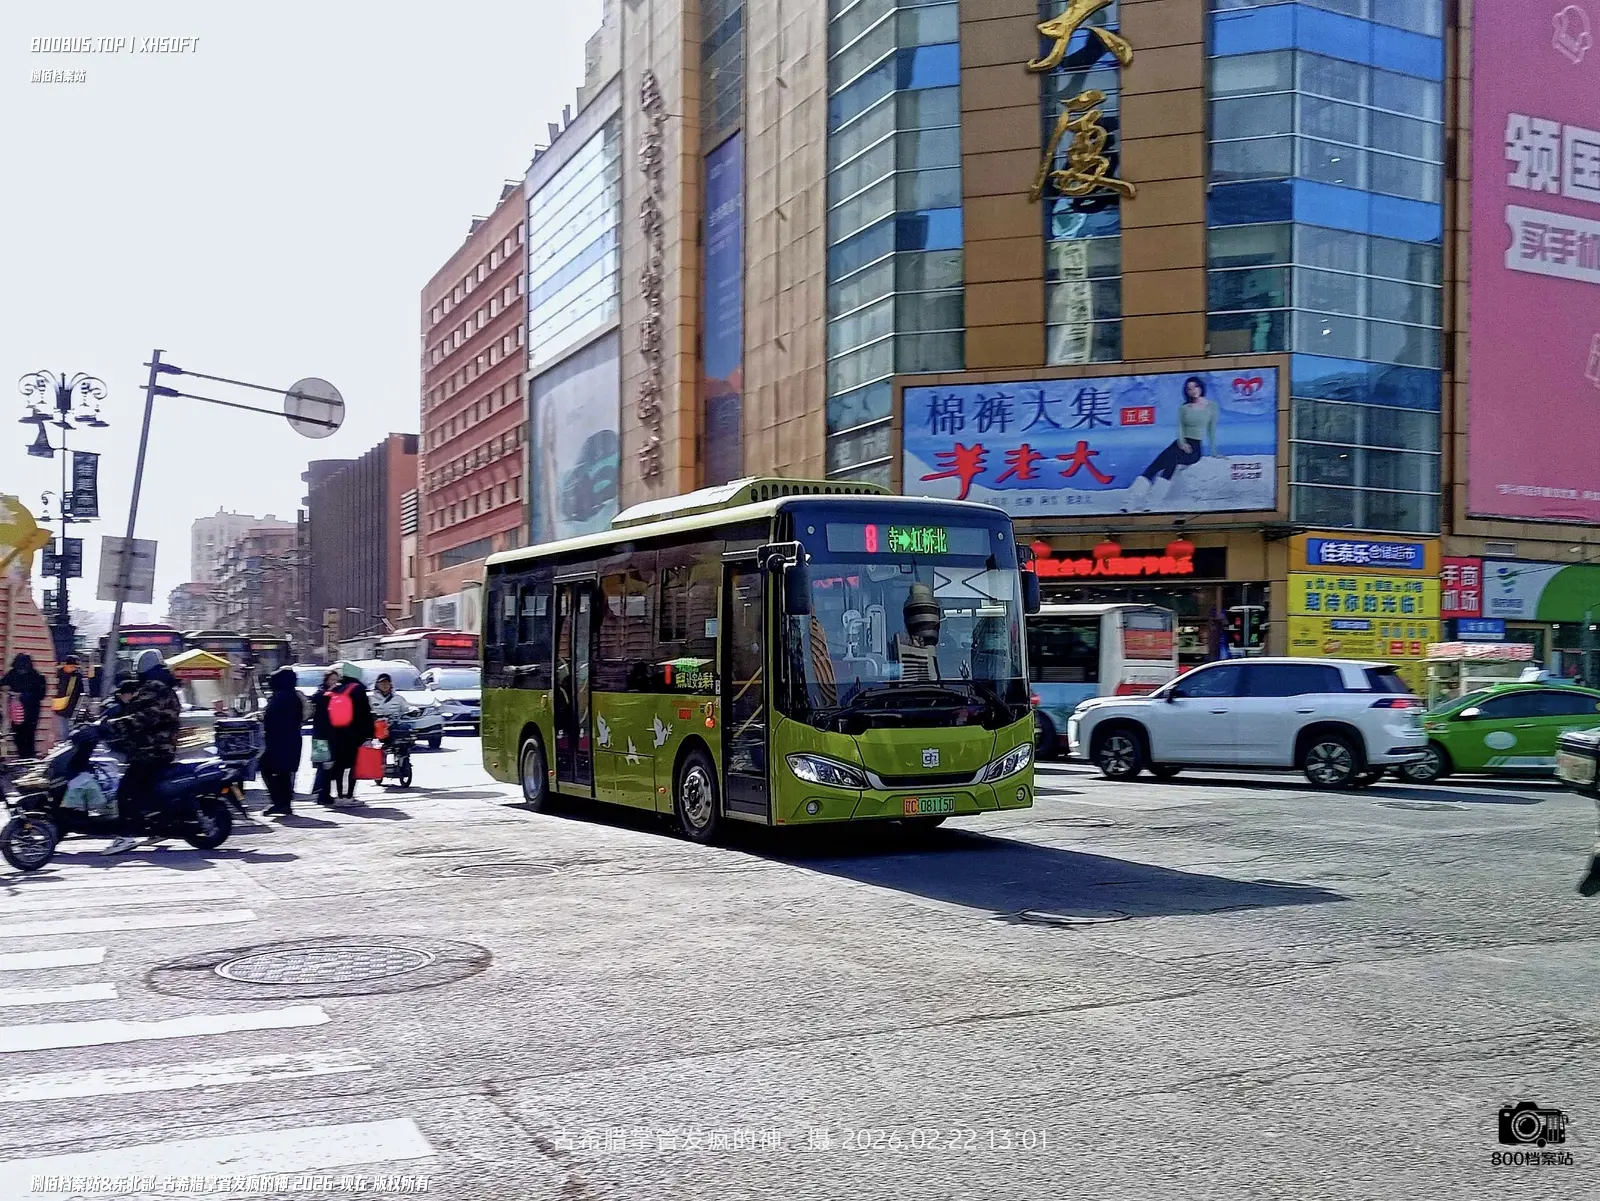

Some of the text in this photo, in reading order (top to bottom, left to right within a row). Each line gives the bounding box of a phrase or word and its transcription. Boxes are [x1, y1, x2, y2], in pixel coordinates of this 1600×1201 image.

[926, 387, 1113, 436] 棉裤大集
[919, 440, 1116, 500] 羊老大
